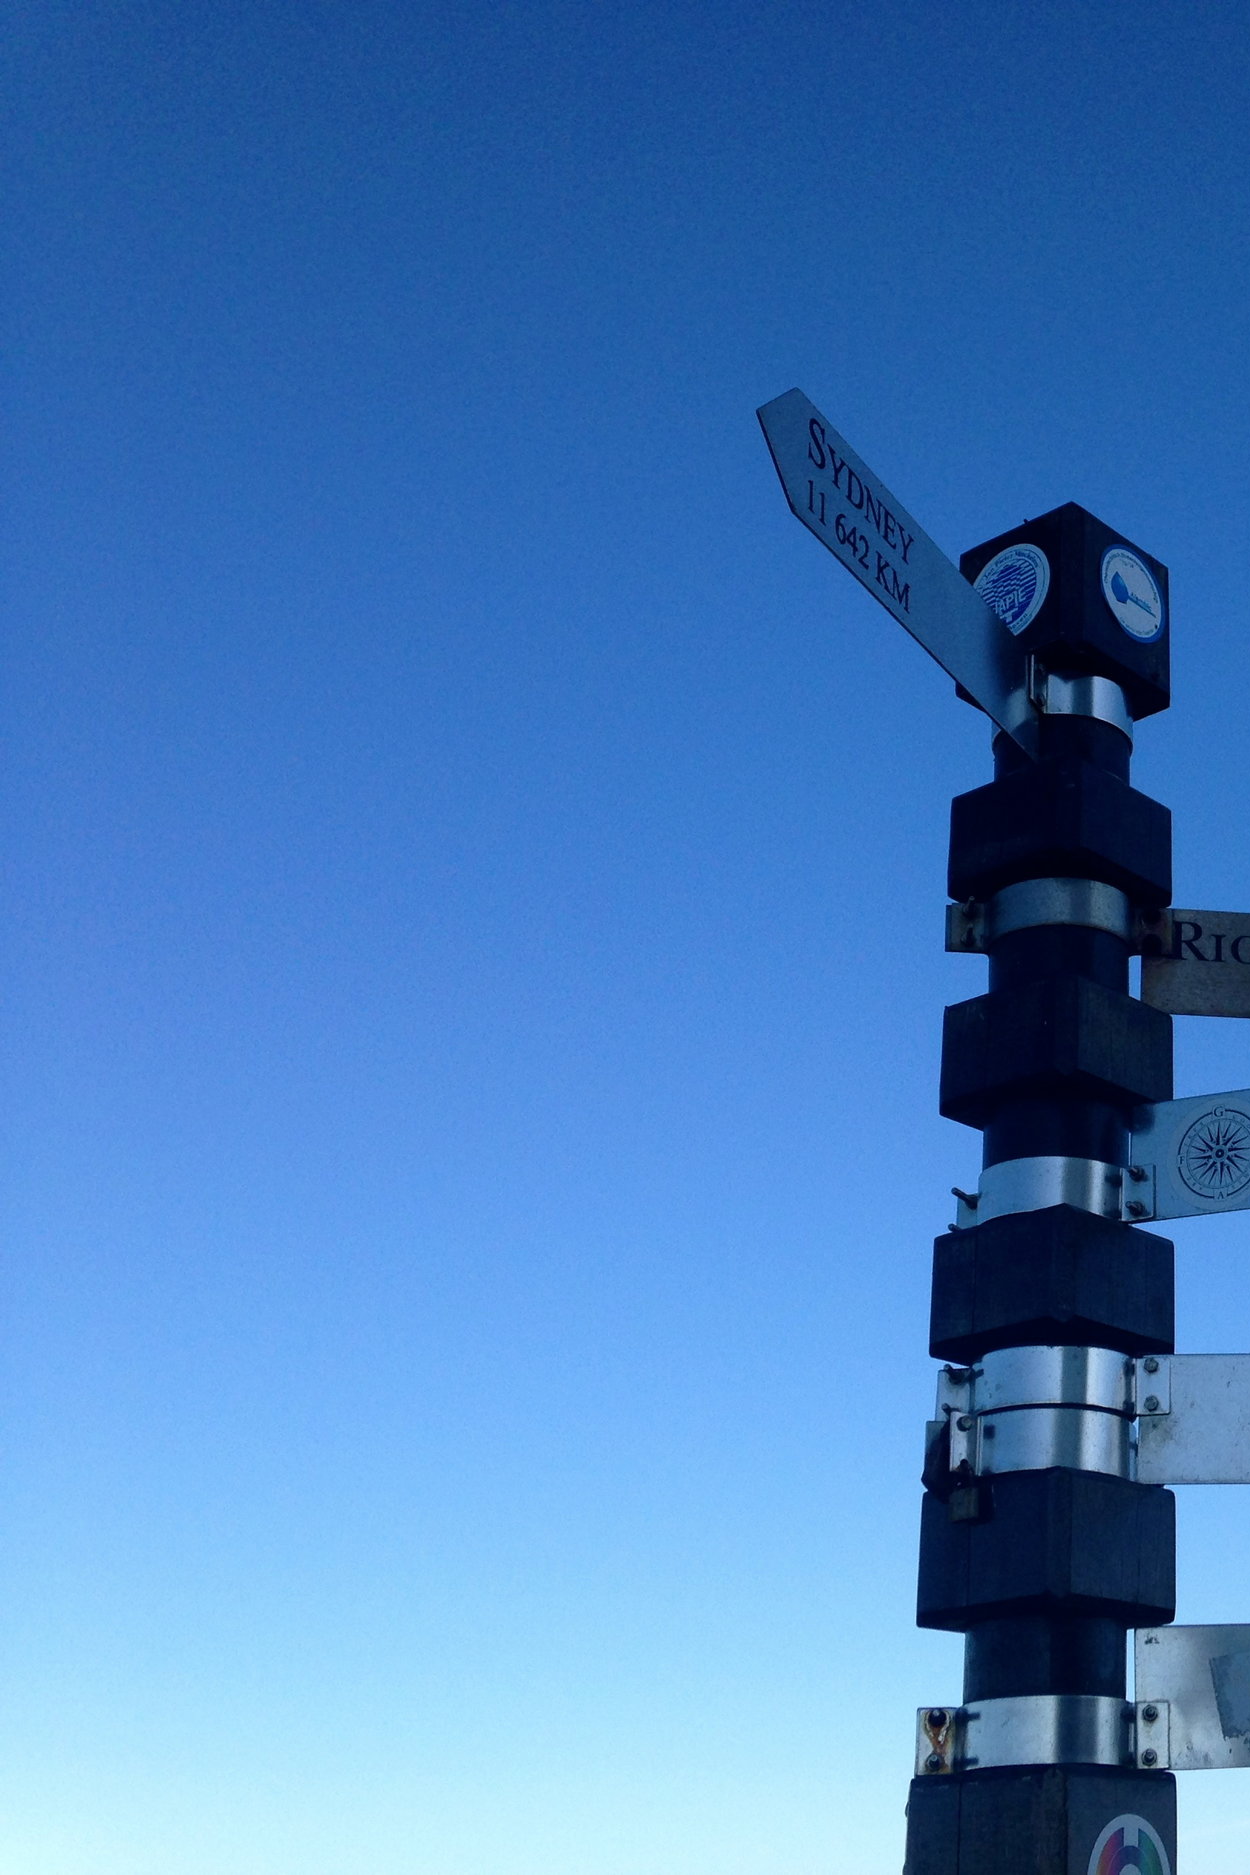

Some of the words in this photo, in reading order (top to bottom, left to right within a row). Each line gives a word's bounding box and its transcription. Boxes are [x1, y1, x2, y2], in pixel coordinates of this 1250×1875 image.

[807, 480, 827, 527] 11
[835, 513, 871, 570] 642
[874, 549, 911, 615] KM
[808, 418, 914, 565] SYDNEY
